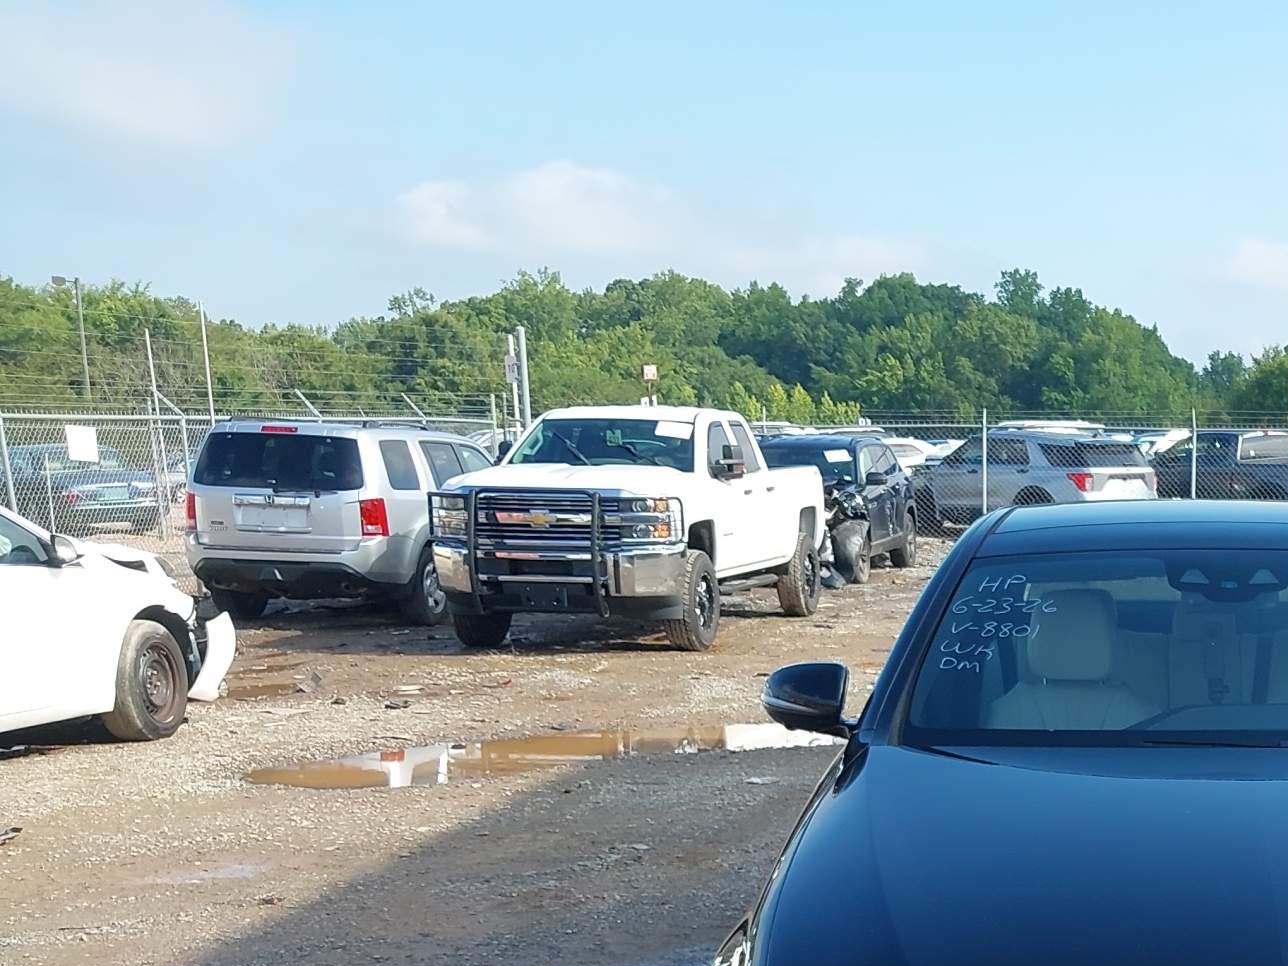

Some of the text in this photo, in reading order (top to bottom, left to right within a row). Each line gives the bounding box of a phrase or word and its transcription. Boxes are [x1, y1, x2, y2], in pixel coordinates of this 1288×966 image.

[978, 575, 1027, 592] HP
[952, 596, 1057, 615] 6-23-26
[951, 621, 1040, 639] V-8801
